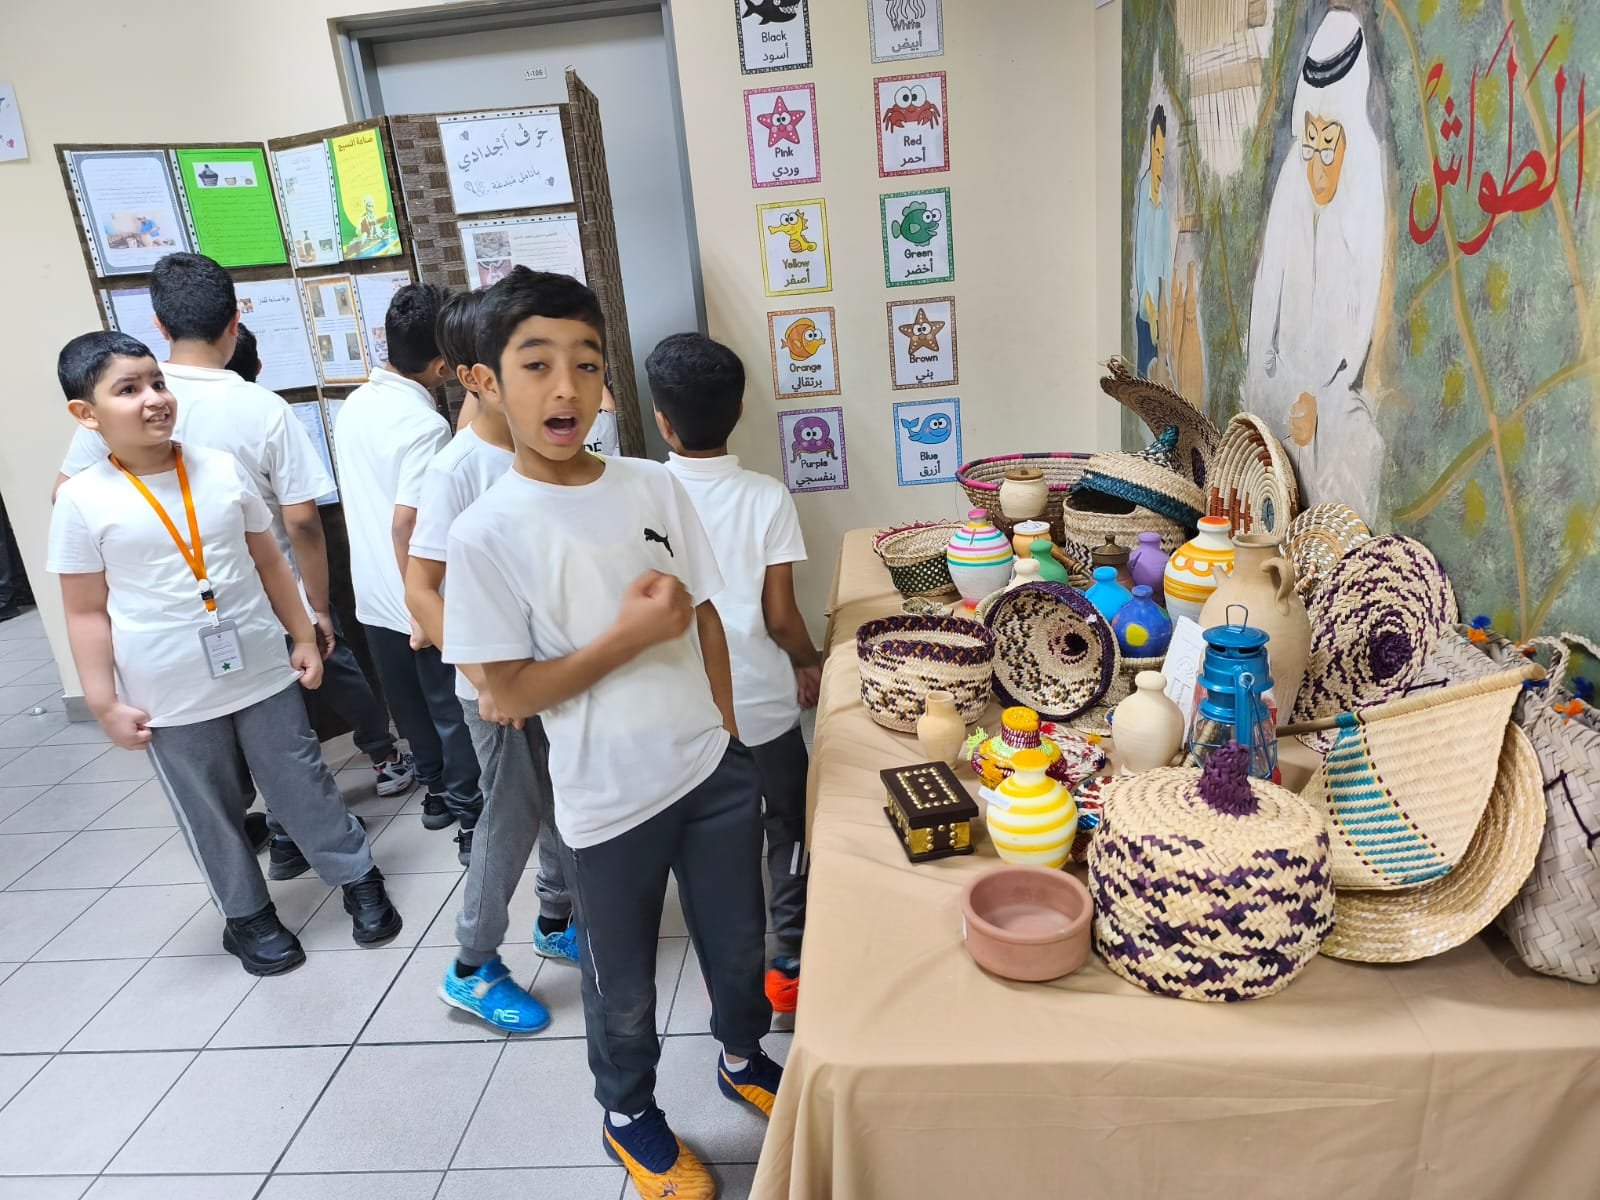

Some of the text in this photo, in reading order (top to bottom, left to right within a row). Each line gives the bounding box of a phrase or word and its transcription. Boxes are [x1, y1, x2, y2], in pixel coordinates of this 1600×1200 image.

[891, 19, 921, 32] White
[761, 30, 787, 43] Black
[891, 31, 922, 53] أبيض
[762, 44, 789, 62] أسود
[903, 135, 922, 147] Red
[775, 146, 794, 158] Pink
[900, 147, 926, 167] أحمر
[772, 165, 800, 180] وردي
[904, 249, 933, 259] Green
[782, 259, 810, 270] Yellow
[904, 258, 934, 278] أخضر
[784, 270, 810, 288] أصفر
[910, 354, 939, 364] Brown
[789, 363, 822, 373] Orange
[915, 370, 934, 384] بني
[791, 377, 823, 393] برتقالي
[920, 451, 939, 461] Blue
[801, 458, 828, 469] Purple
[919, 461, 941, 477] أزرق
[795, 472, 837, 488] بنفسجي
